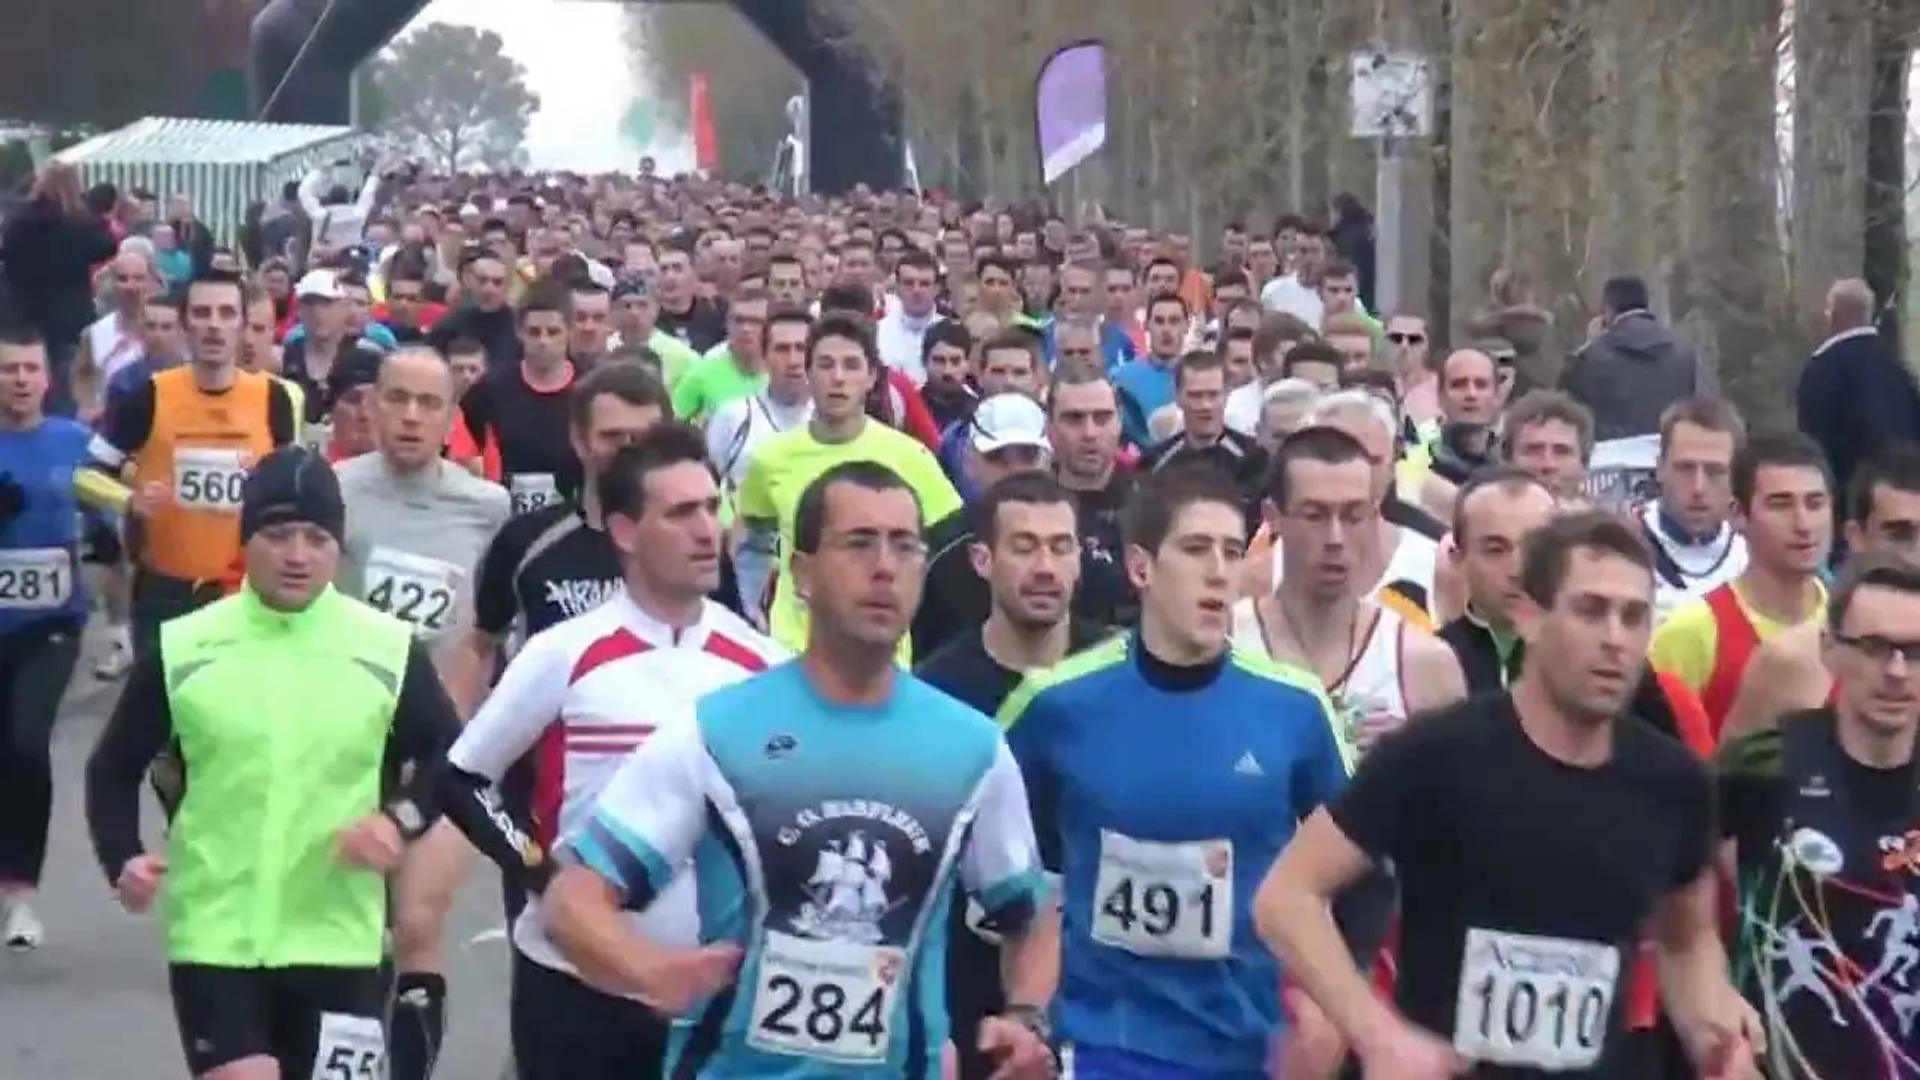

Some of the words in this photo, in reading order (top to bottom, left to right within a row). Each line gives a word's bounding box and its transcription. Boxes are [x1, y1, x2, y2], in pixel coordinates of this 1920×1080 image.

[180, 470, 243, 503] 560
[368, 576, 450, 630] 422
[1101, 877, 1214, 937] 491
[759, 973, 886, 1047] 284
[1473, 972, 1604, 1048] 1010
